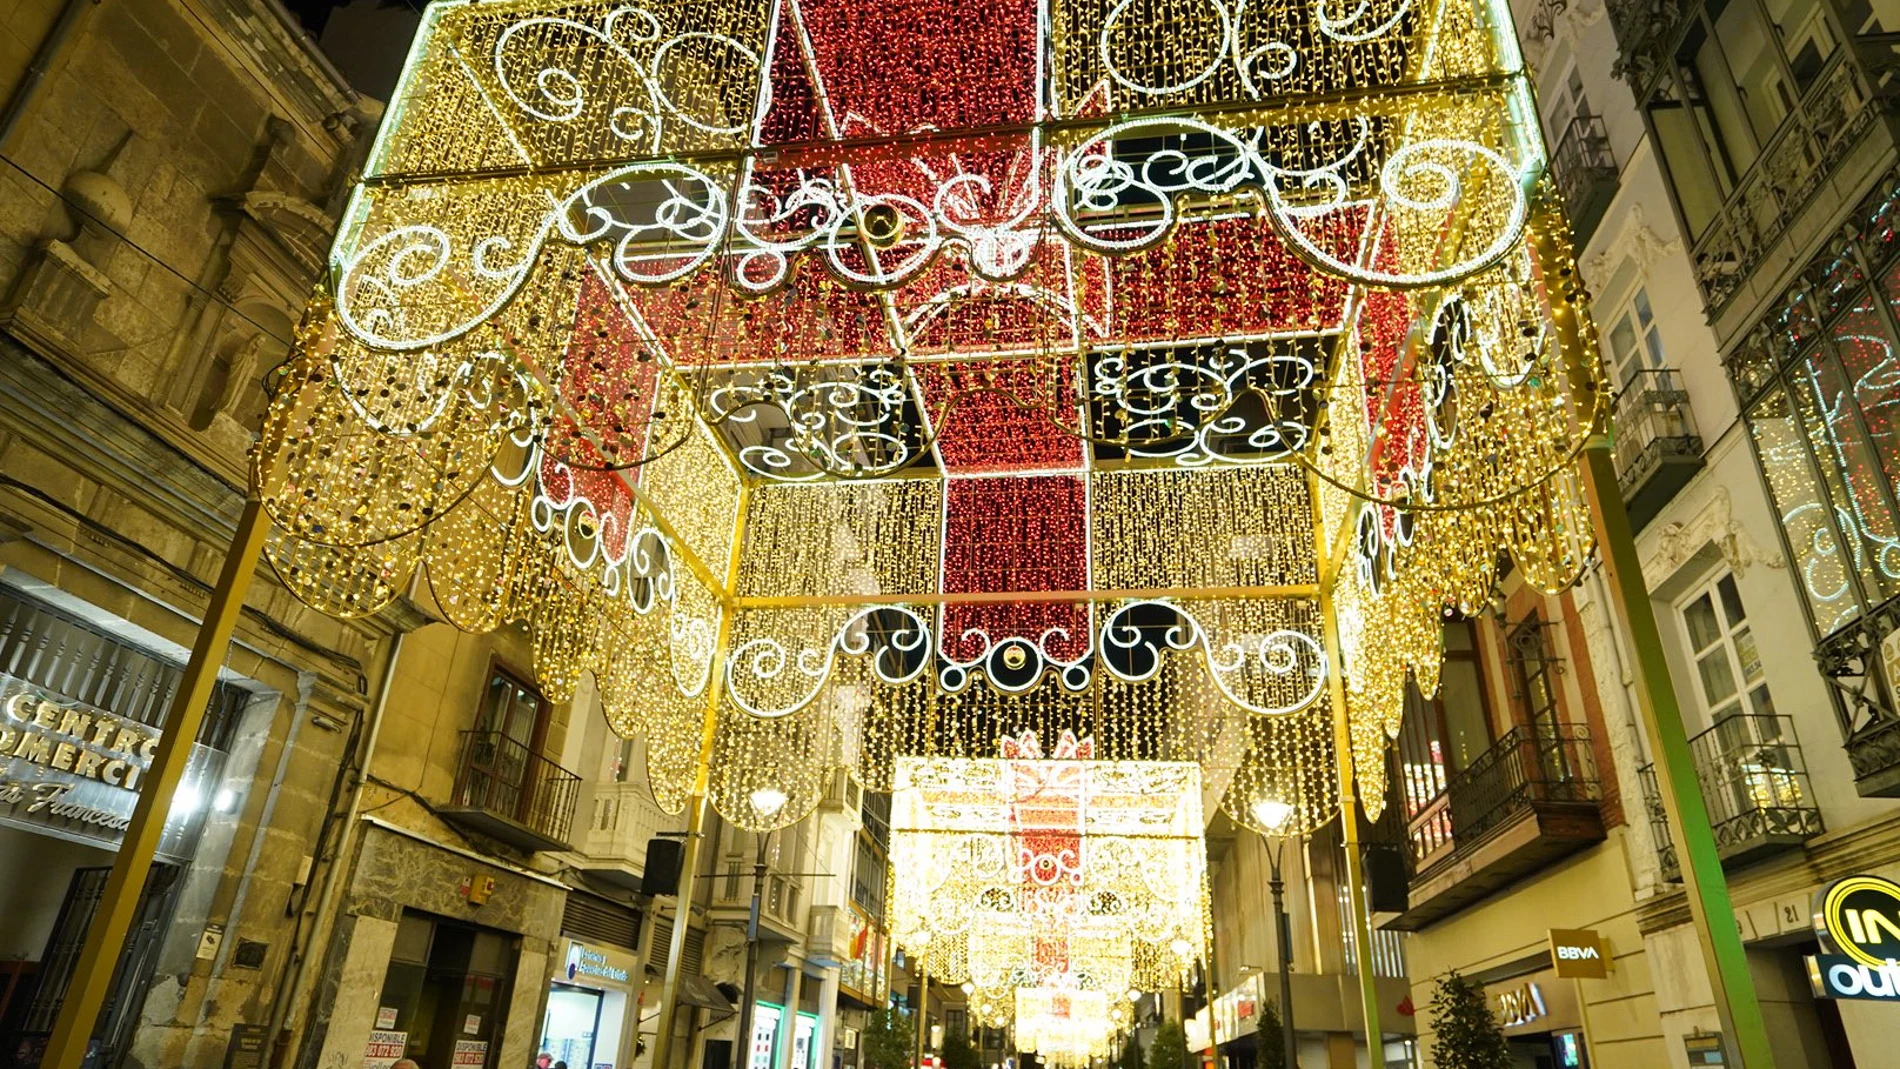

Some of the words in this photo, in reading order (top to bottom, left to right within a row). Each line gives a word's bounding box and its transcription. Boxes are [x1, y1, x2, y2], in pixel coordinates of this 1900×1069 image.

[0, 725, 141, 792] OMERCI
[1784, 904, 1799, 924] 21
[1557, 946, 1600, 960] BBVA
